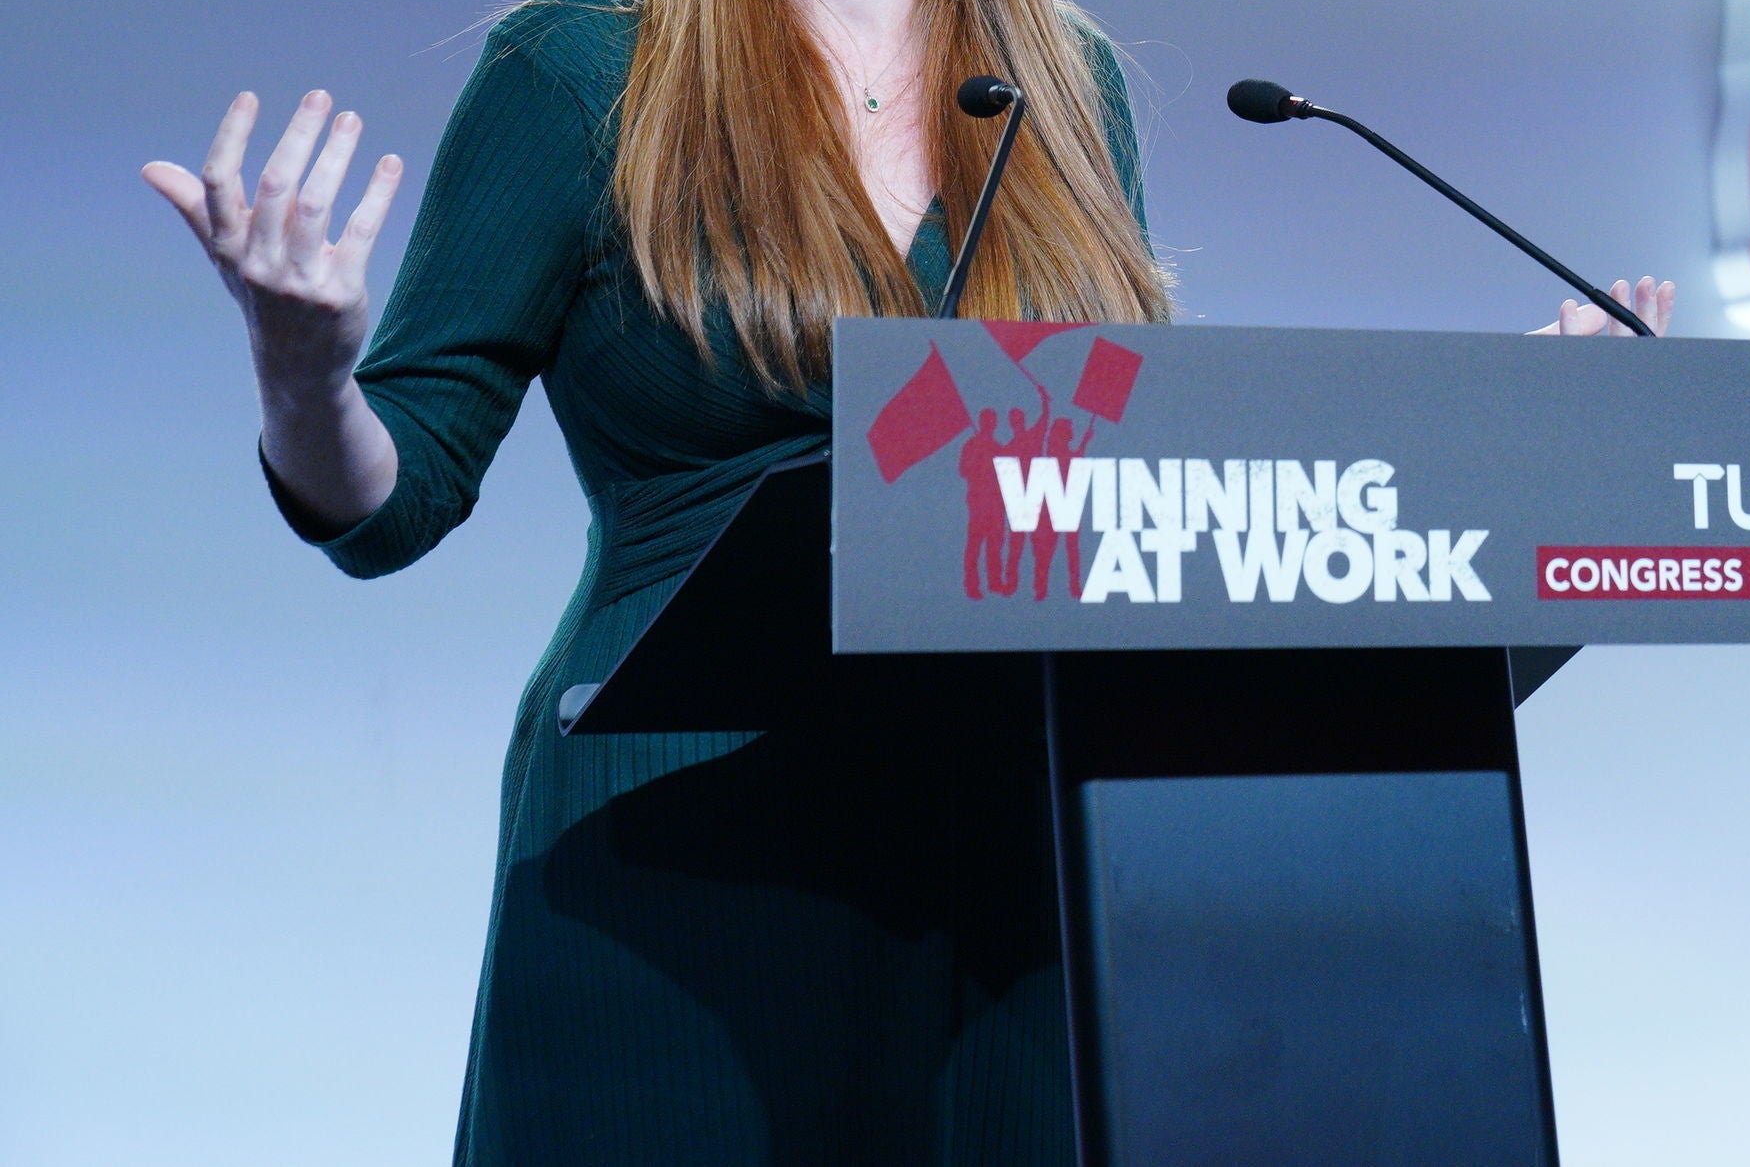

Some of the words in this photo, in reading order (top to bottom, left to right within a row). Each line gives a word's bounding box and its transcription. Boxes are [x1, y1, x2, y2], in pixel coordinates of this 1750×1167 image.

[992, 456, 1398, 533] WINNING
[1080, 529, 1196, 604] AT
[1211, 529, 1492, 604] WORK
[1544, 556, 1743, 593] CONGRESS
